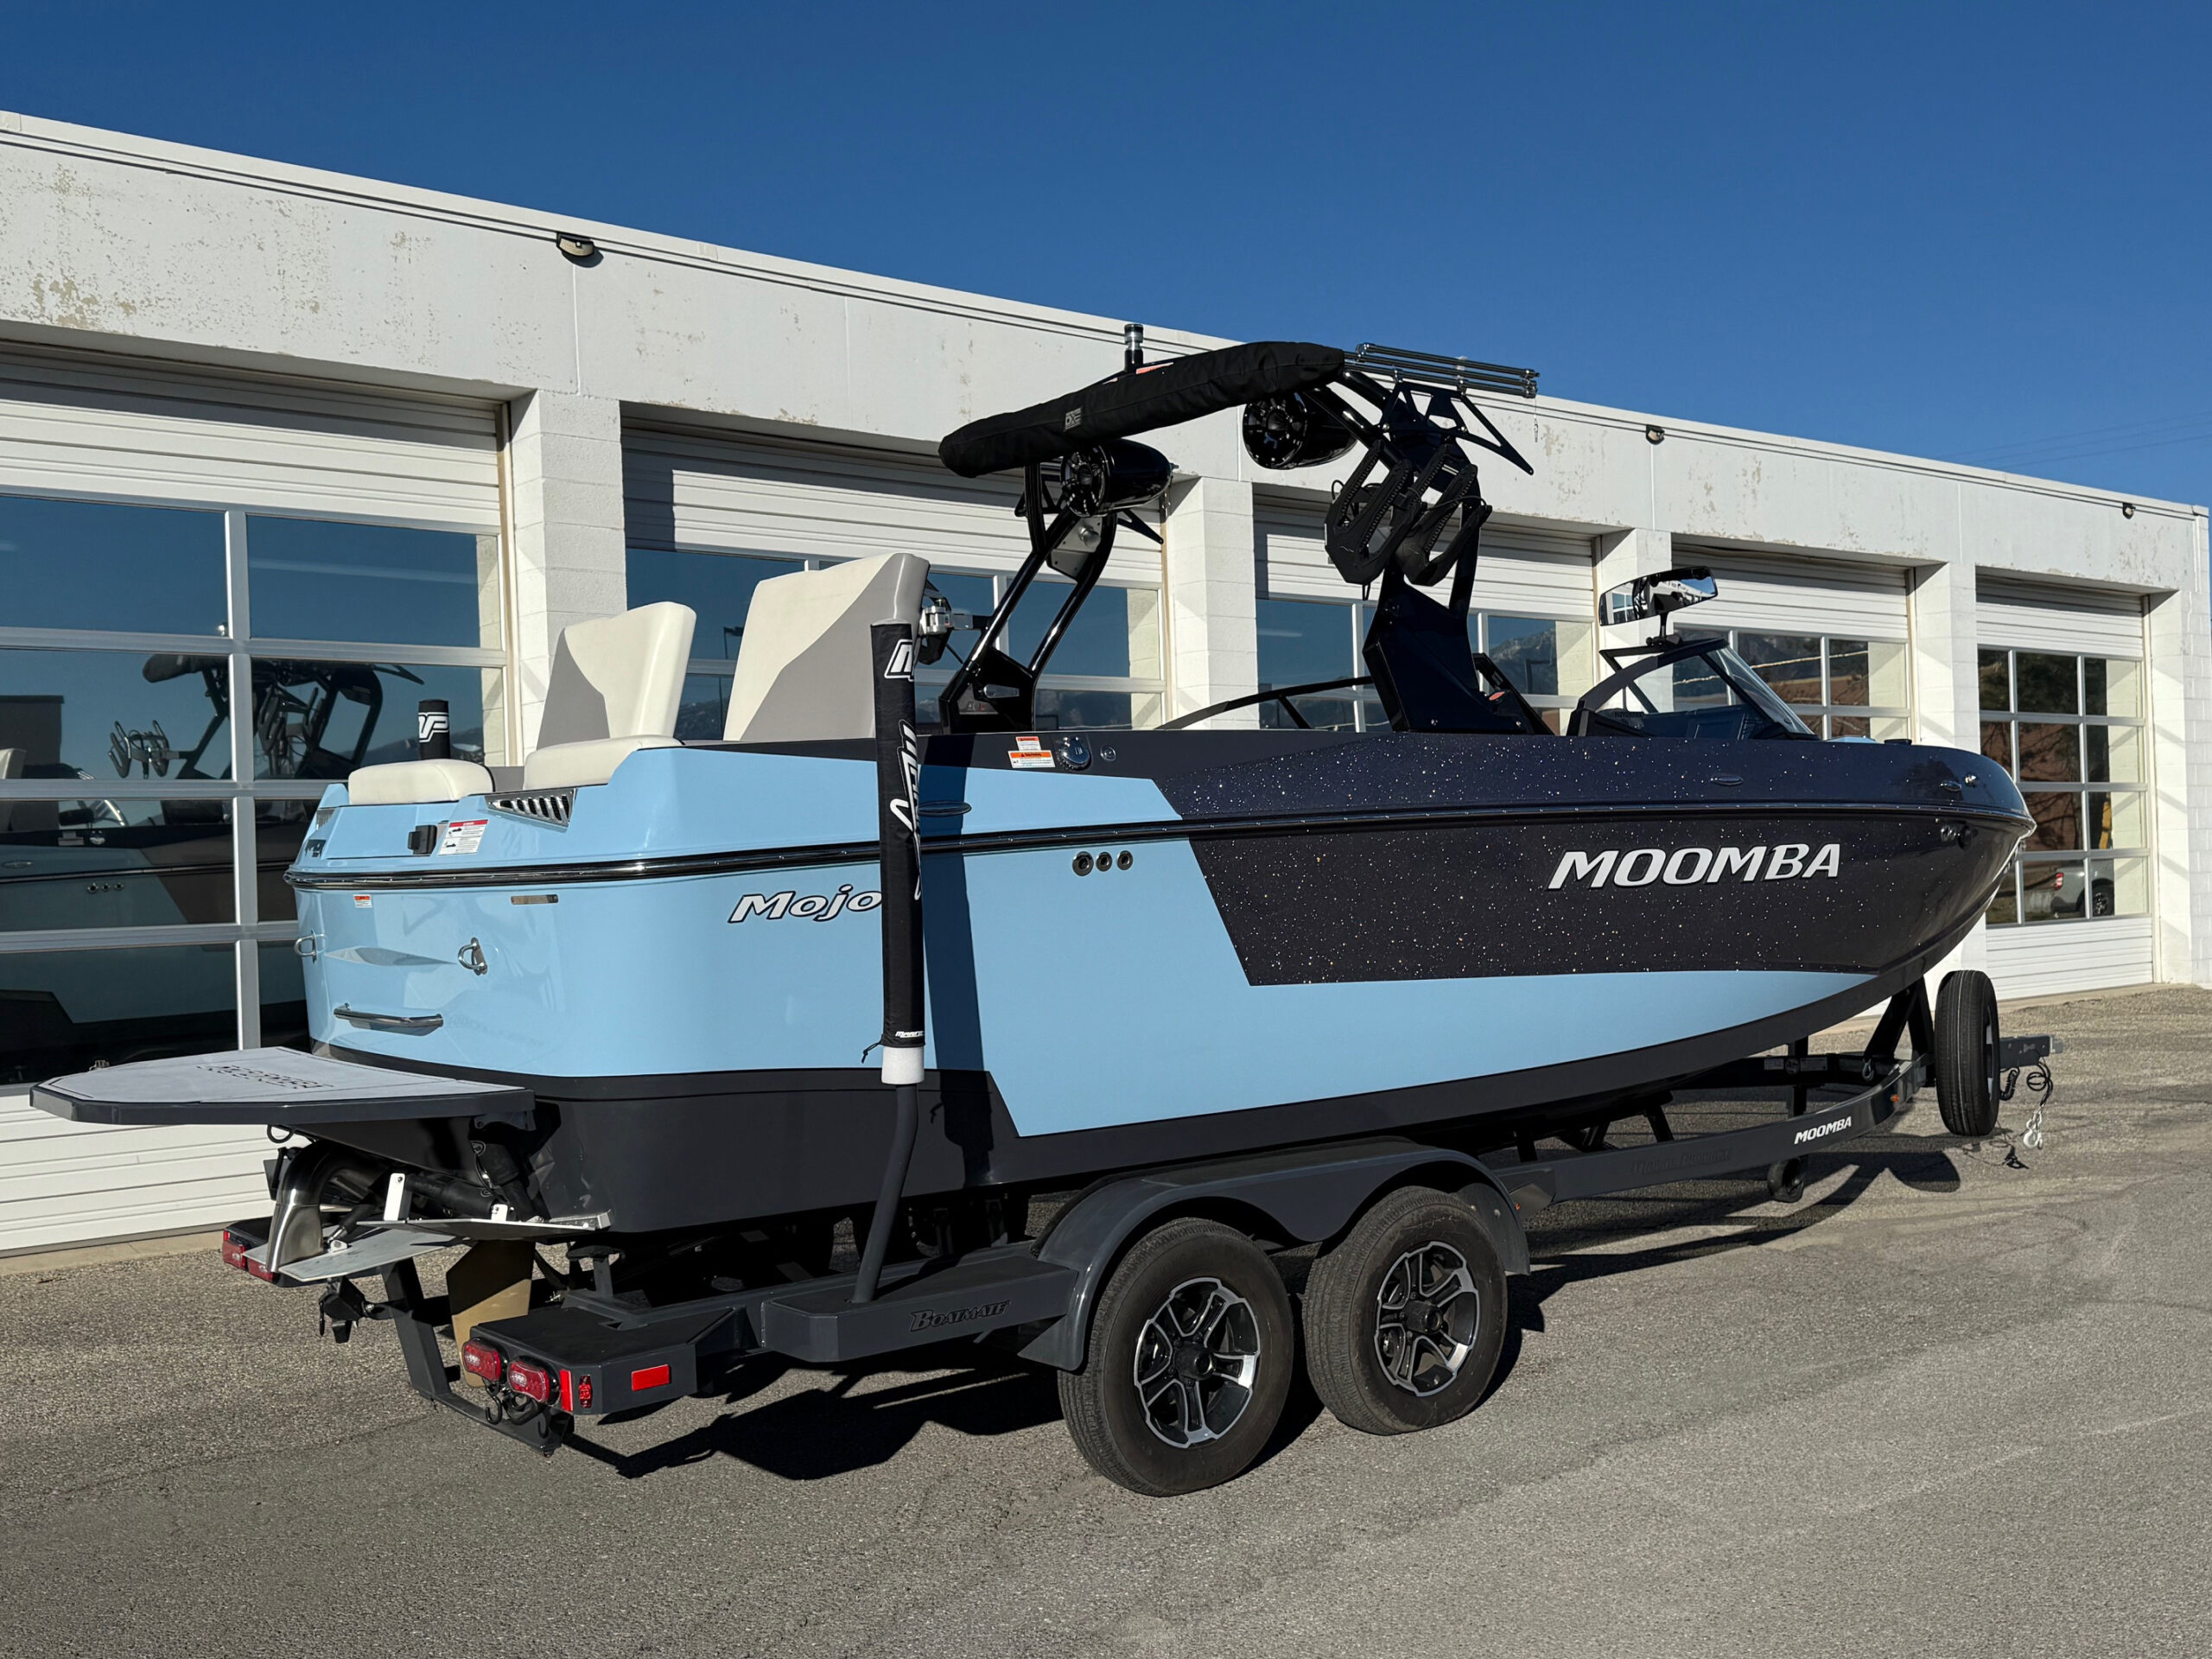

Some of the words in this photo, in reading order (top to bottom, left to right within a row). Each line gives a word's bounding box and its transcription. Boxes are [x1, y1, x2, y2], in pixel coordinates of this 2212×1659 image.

[1547, 843, 1840, 890] MOOMBA
[728, 884, 882, 923] Mojo
[1794, 1116, 1852, 1145] MOOMBA
[910, 1300, 1010, 1332] BOATMATE
